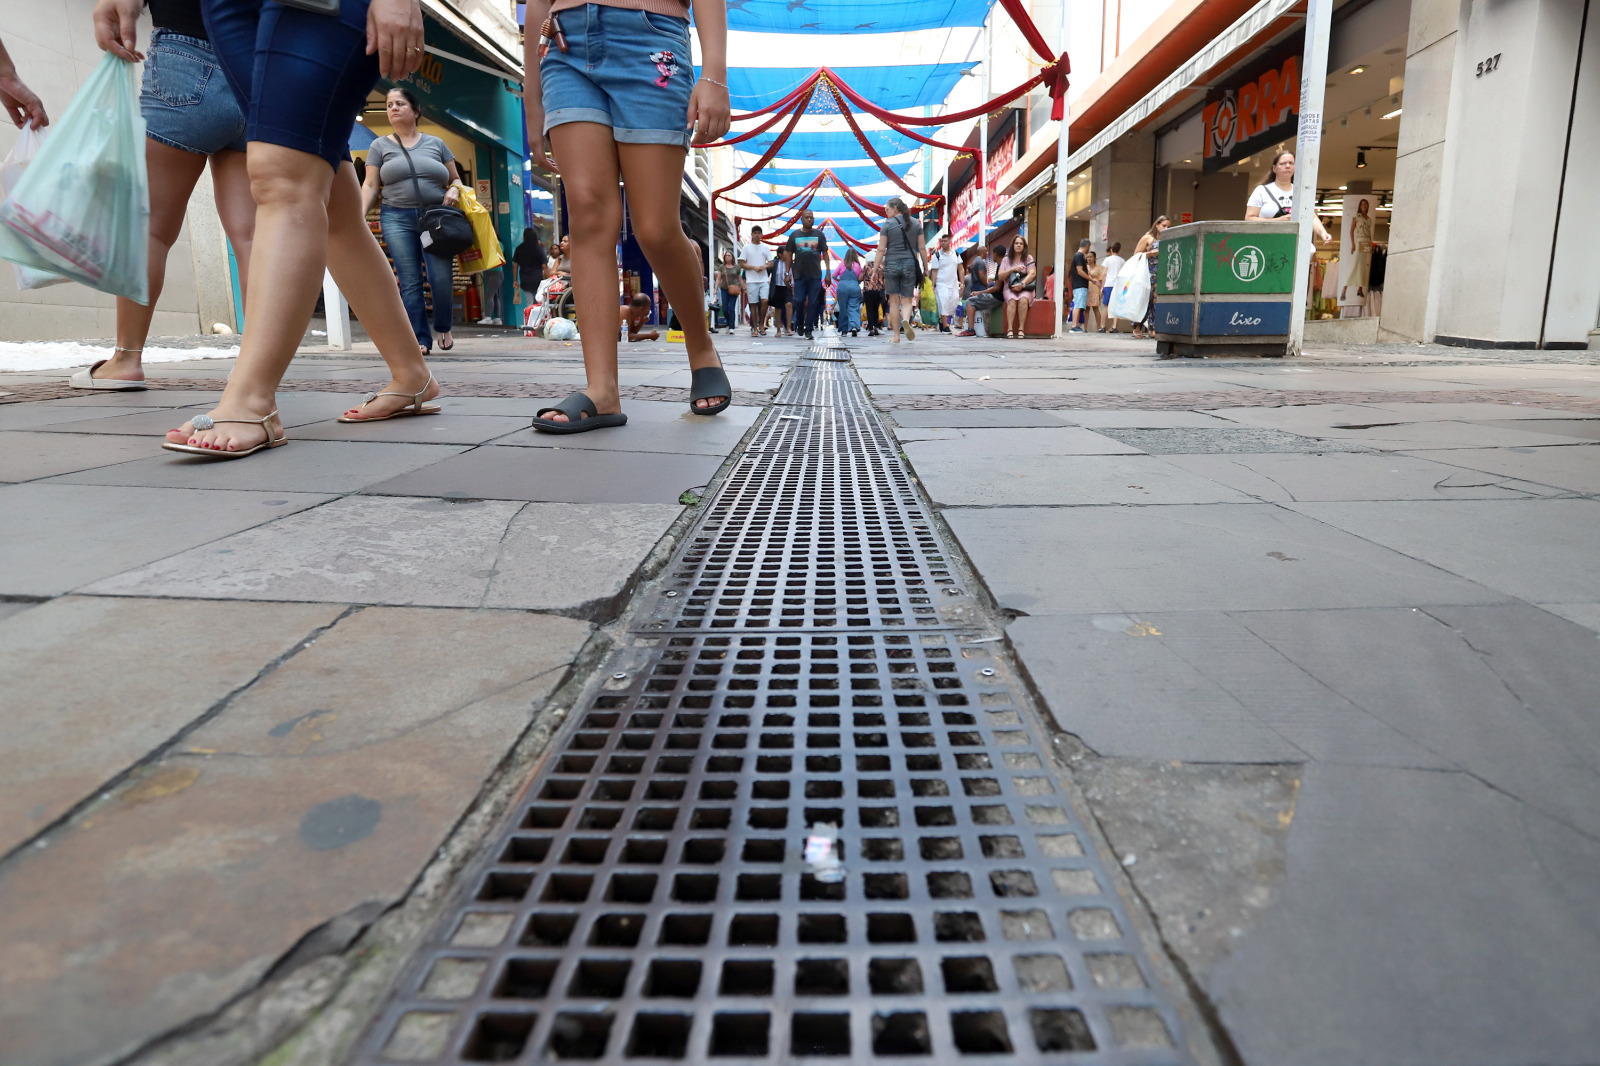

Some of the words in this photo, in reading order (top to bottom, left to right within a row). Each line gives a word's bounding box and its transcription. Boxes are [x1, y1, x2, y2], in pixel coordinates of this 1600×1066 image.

[1476, 53, 1502, 77] 527
[1202, 55, 1300, 158] TORRA
[1166, 312, 1180, 325] lixo
[1229, 311, 1262, 325] lixo
